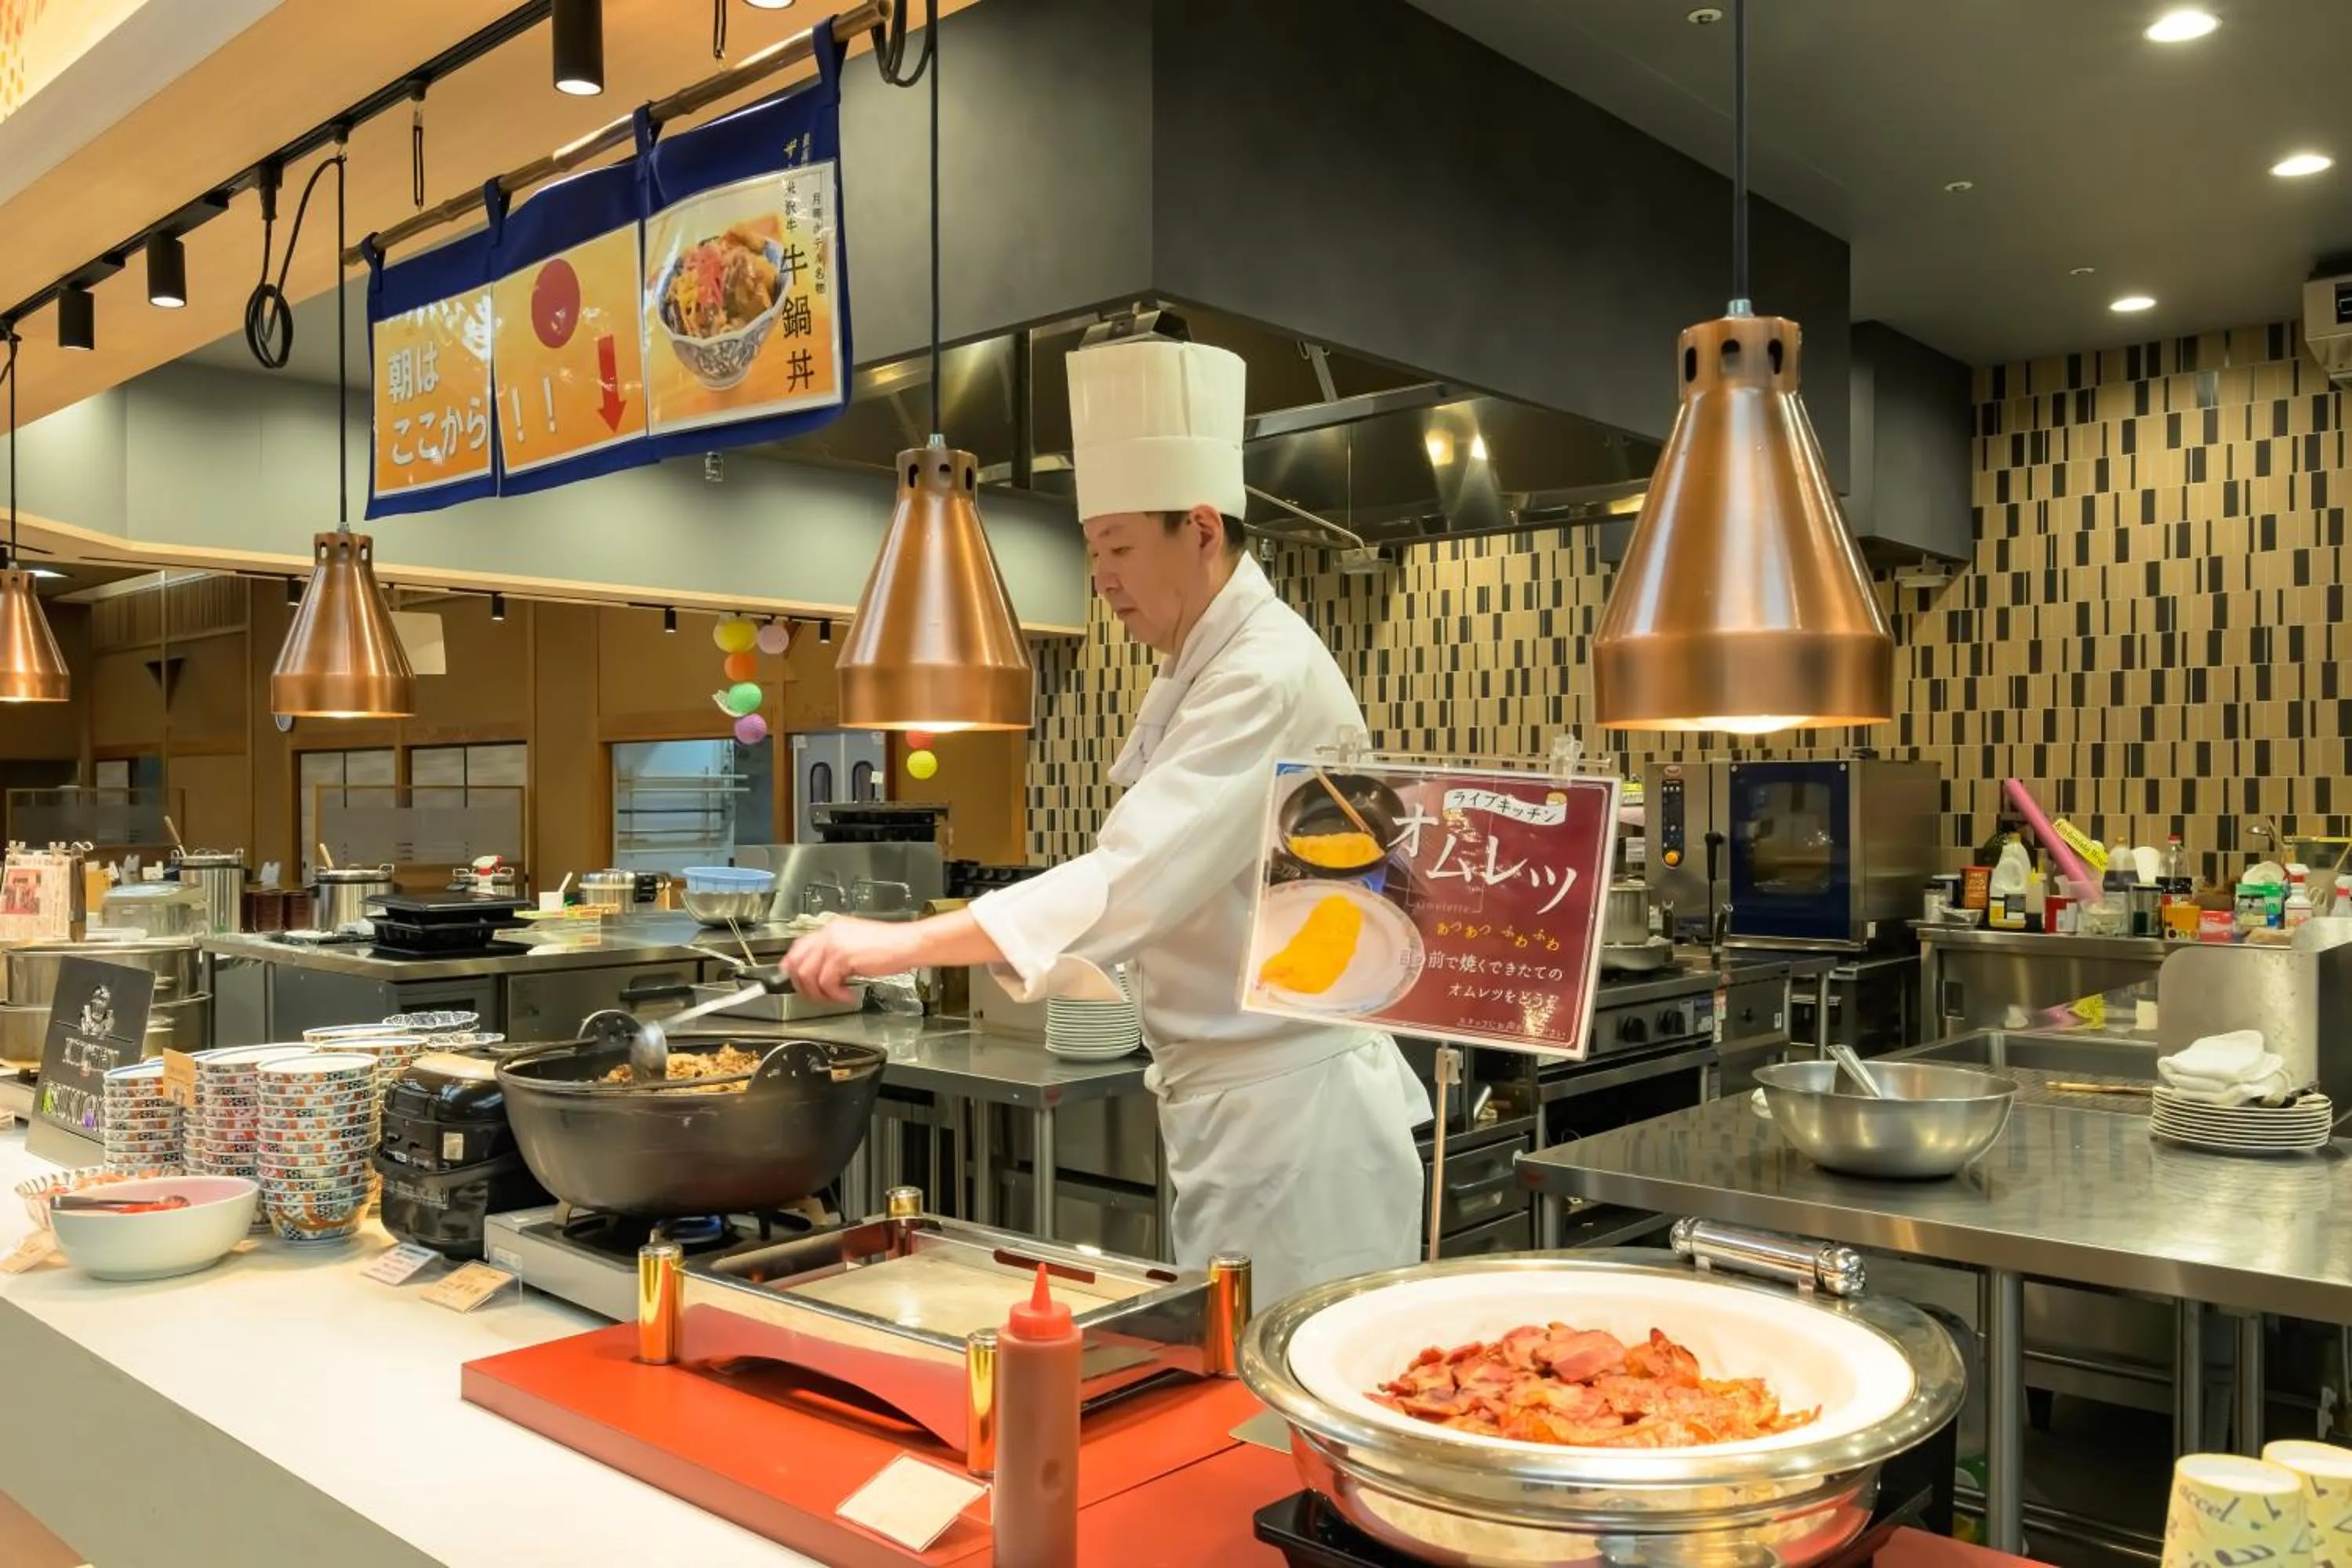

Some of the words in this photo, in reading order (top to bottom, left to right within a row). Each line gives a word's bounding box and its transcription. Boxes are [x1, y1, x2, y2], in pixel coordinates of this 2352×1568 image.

[780, 244, 815, 393] 牛鍋丼
[389, 339, 438, 404] 朝は
[392, 397, 488, 466] ここから
[1387, 803, 1577, 915] オムレツ
